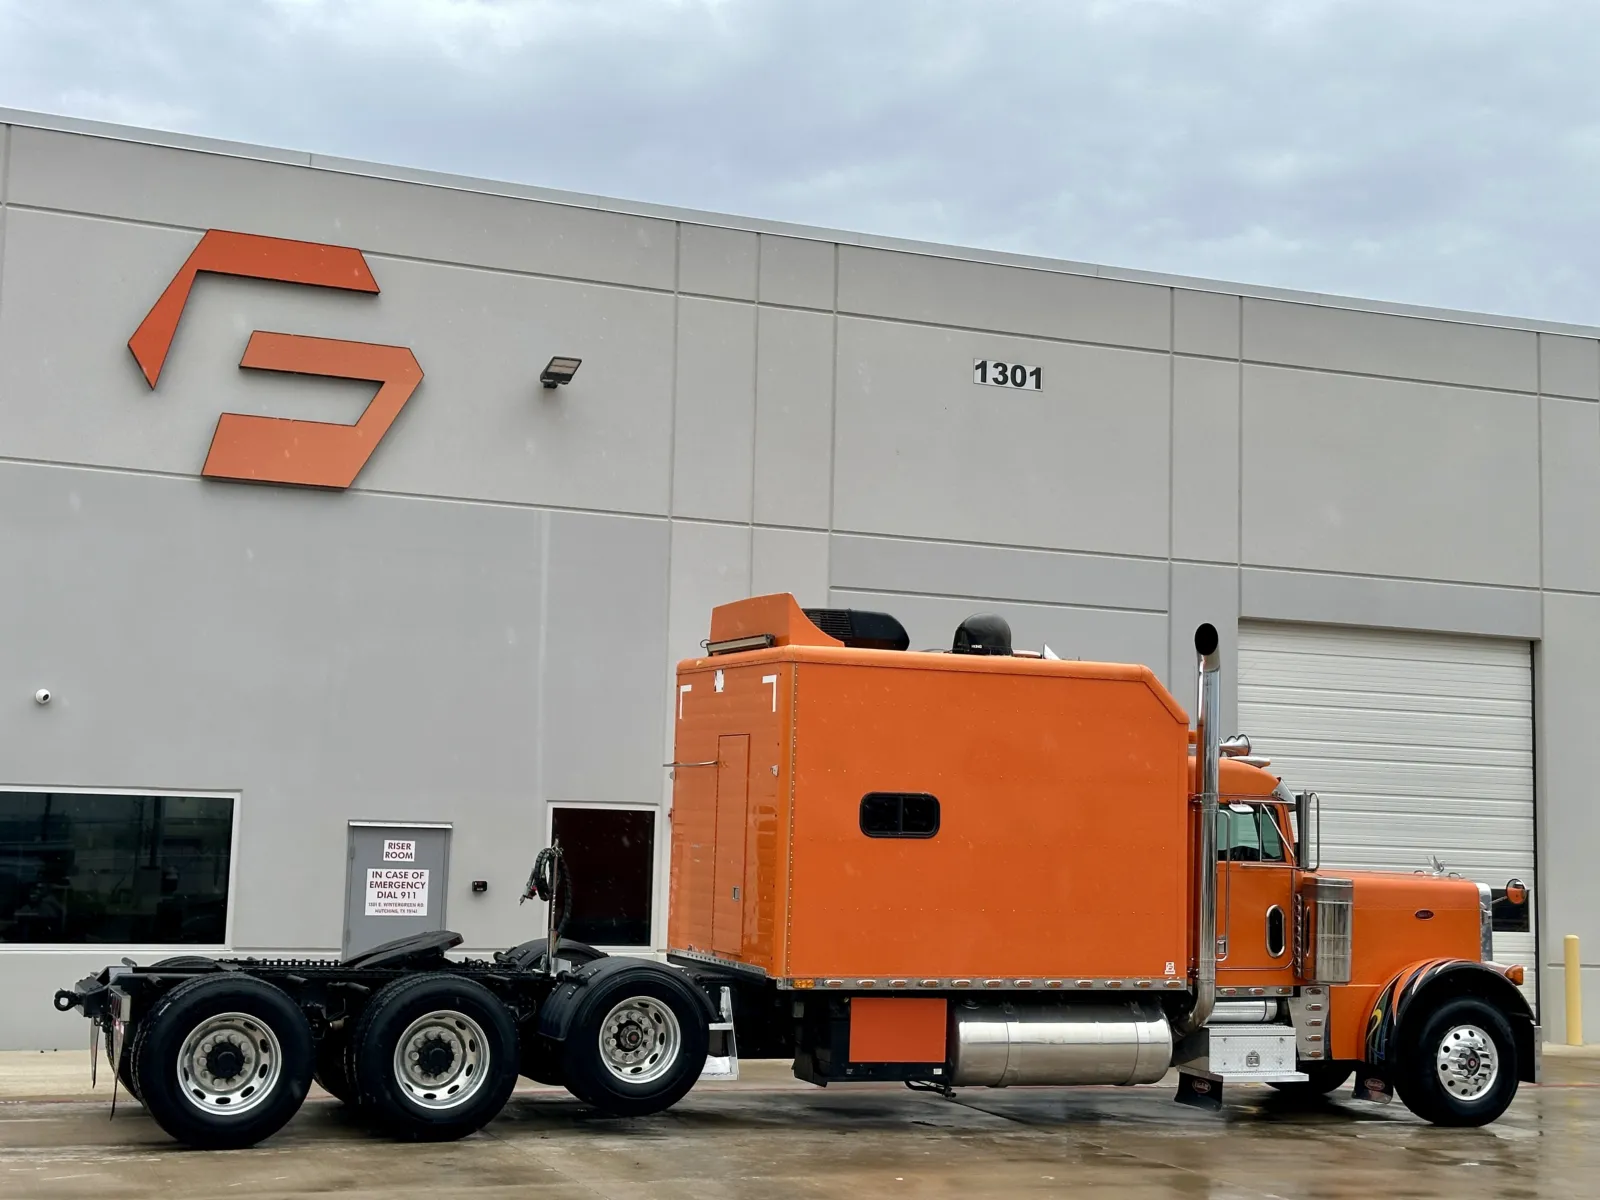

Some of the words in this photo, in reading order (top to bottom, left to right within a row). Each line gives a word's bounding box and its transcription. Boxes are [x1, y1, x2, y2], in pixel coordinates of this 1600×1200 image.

[975, 360, 1041, 389] 1301
[388, 842, 411, 850] RISER
[385, 851, 413, 859] ROOM
[385, 871, 409, 879] CASE
[412, 871, 424, 879] OF
[370, 881, 426, 889] EMERGENCY
[377, 891, 397, 899] DIAL
[401, 891, 416, 899] 911
